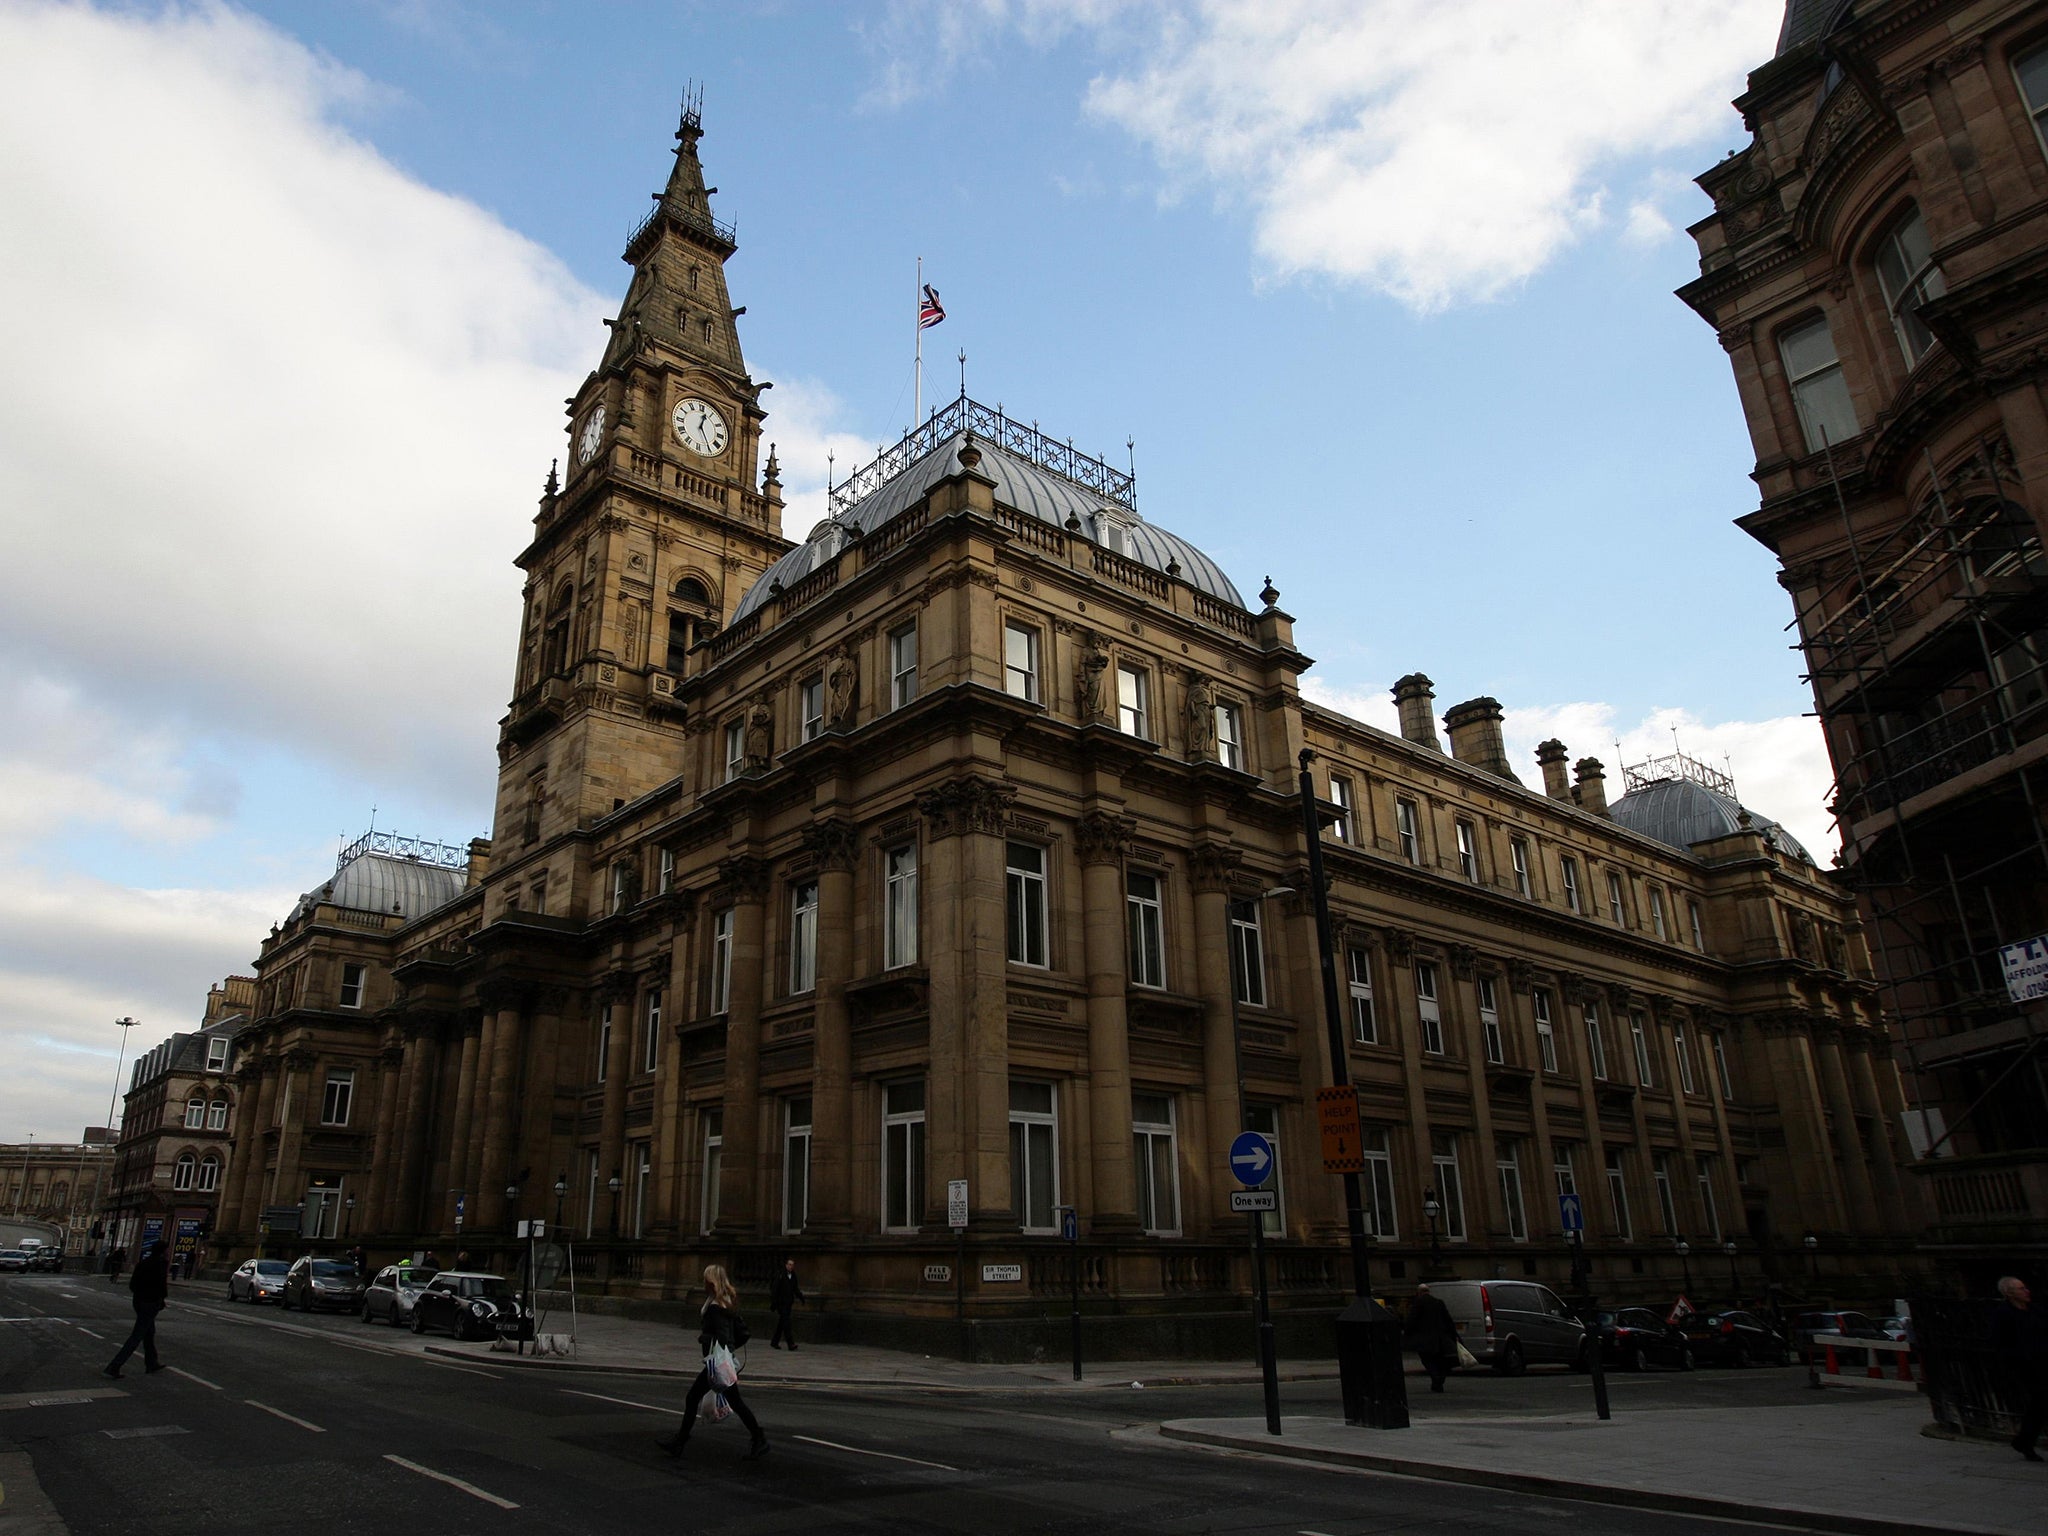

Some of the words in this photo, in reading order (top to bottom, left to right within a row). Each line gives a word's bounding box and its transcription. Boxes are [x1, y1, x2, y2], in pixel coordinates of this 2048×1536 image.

[1323, 1106, 1351, 1117] HELP
[1323, 1122, 1355, 1135] POINT
[1235, 1196, 1252, 1206] One
[1254, 1197, 1272, 1207] way
